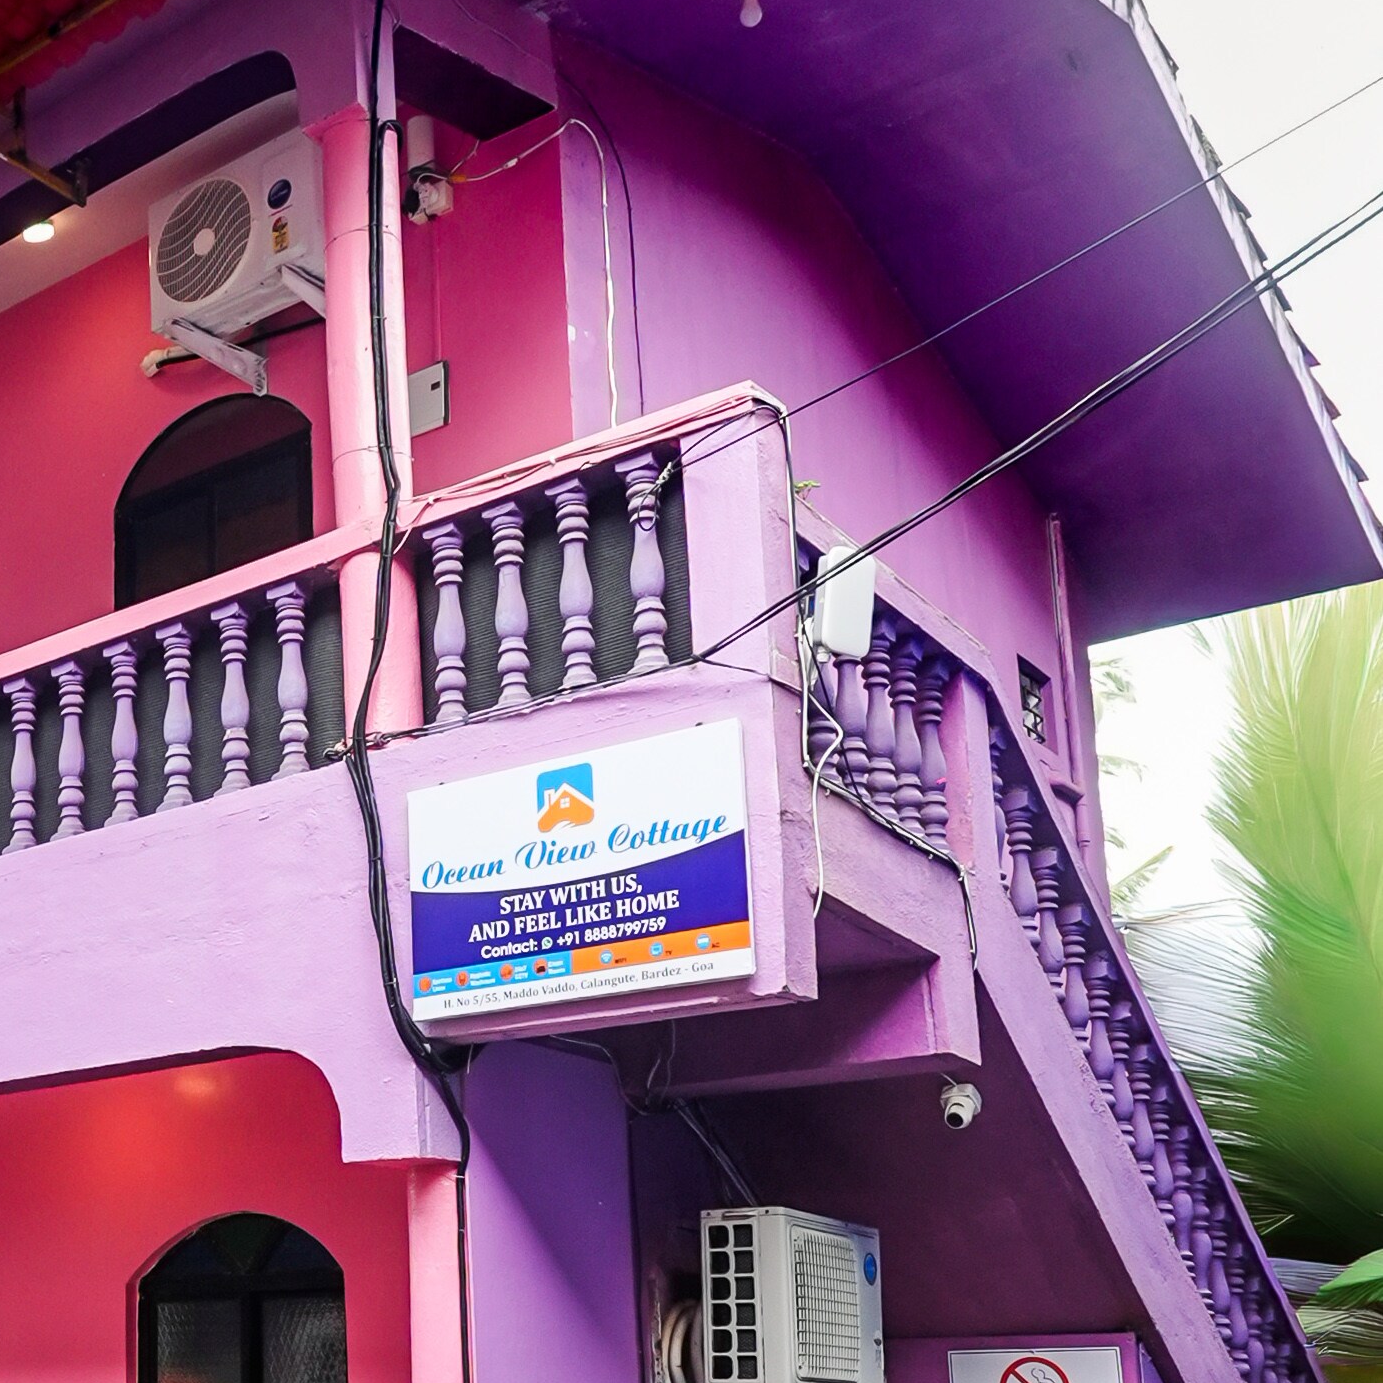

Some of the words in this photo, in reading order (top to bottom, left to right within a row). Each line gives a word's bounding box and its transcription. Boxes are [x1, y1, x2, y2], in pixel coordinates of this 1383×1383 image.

[422, 860, 506, 889] Ocean
[514, 840, 597, 870] View
[608, 815, 729, 853] Cottage
[468, 920, 510, 943] AND
[514, 911, 562, 935] FEEL
[565, 901, 612, 927] LIKE
[616, 889, 680, 918] HOME
[500, 890, 546, 915] STAY
[549, 879, 606, 906] WITH
[611, 873, 643, 895] US,
[480, 938, 538, 959] Contact:
[557, 931, 580, 946] +91
[584, 916, 667, 943] 8888799759
[457, 997, 470, 1008] No
[472, 992, 501, 1006] 5/55,
[503, 987, 539, 1002] Maddo
[541, 981, 578, 996] Vaddo,
[580, 974, 638, 990] Calangute,
[641, 966, 681, 981] Bardez
[691, 961, 714, 973] Goa
